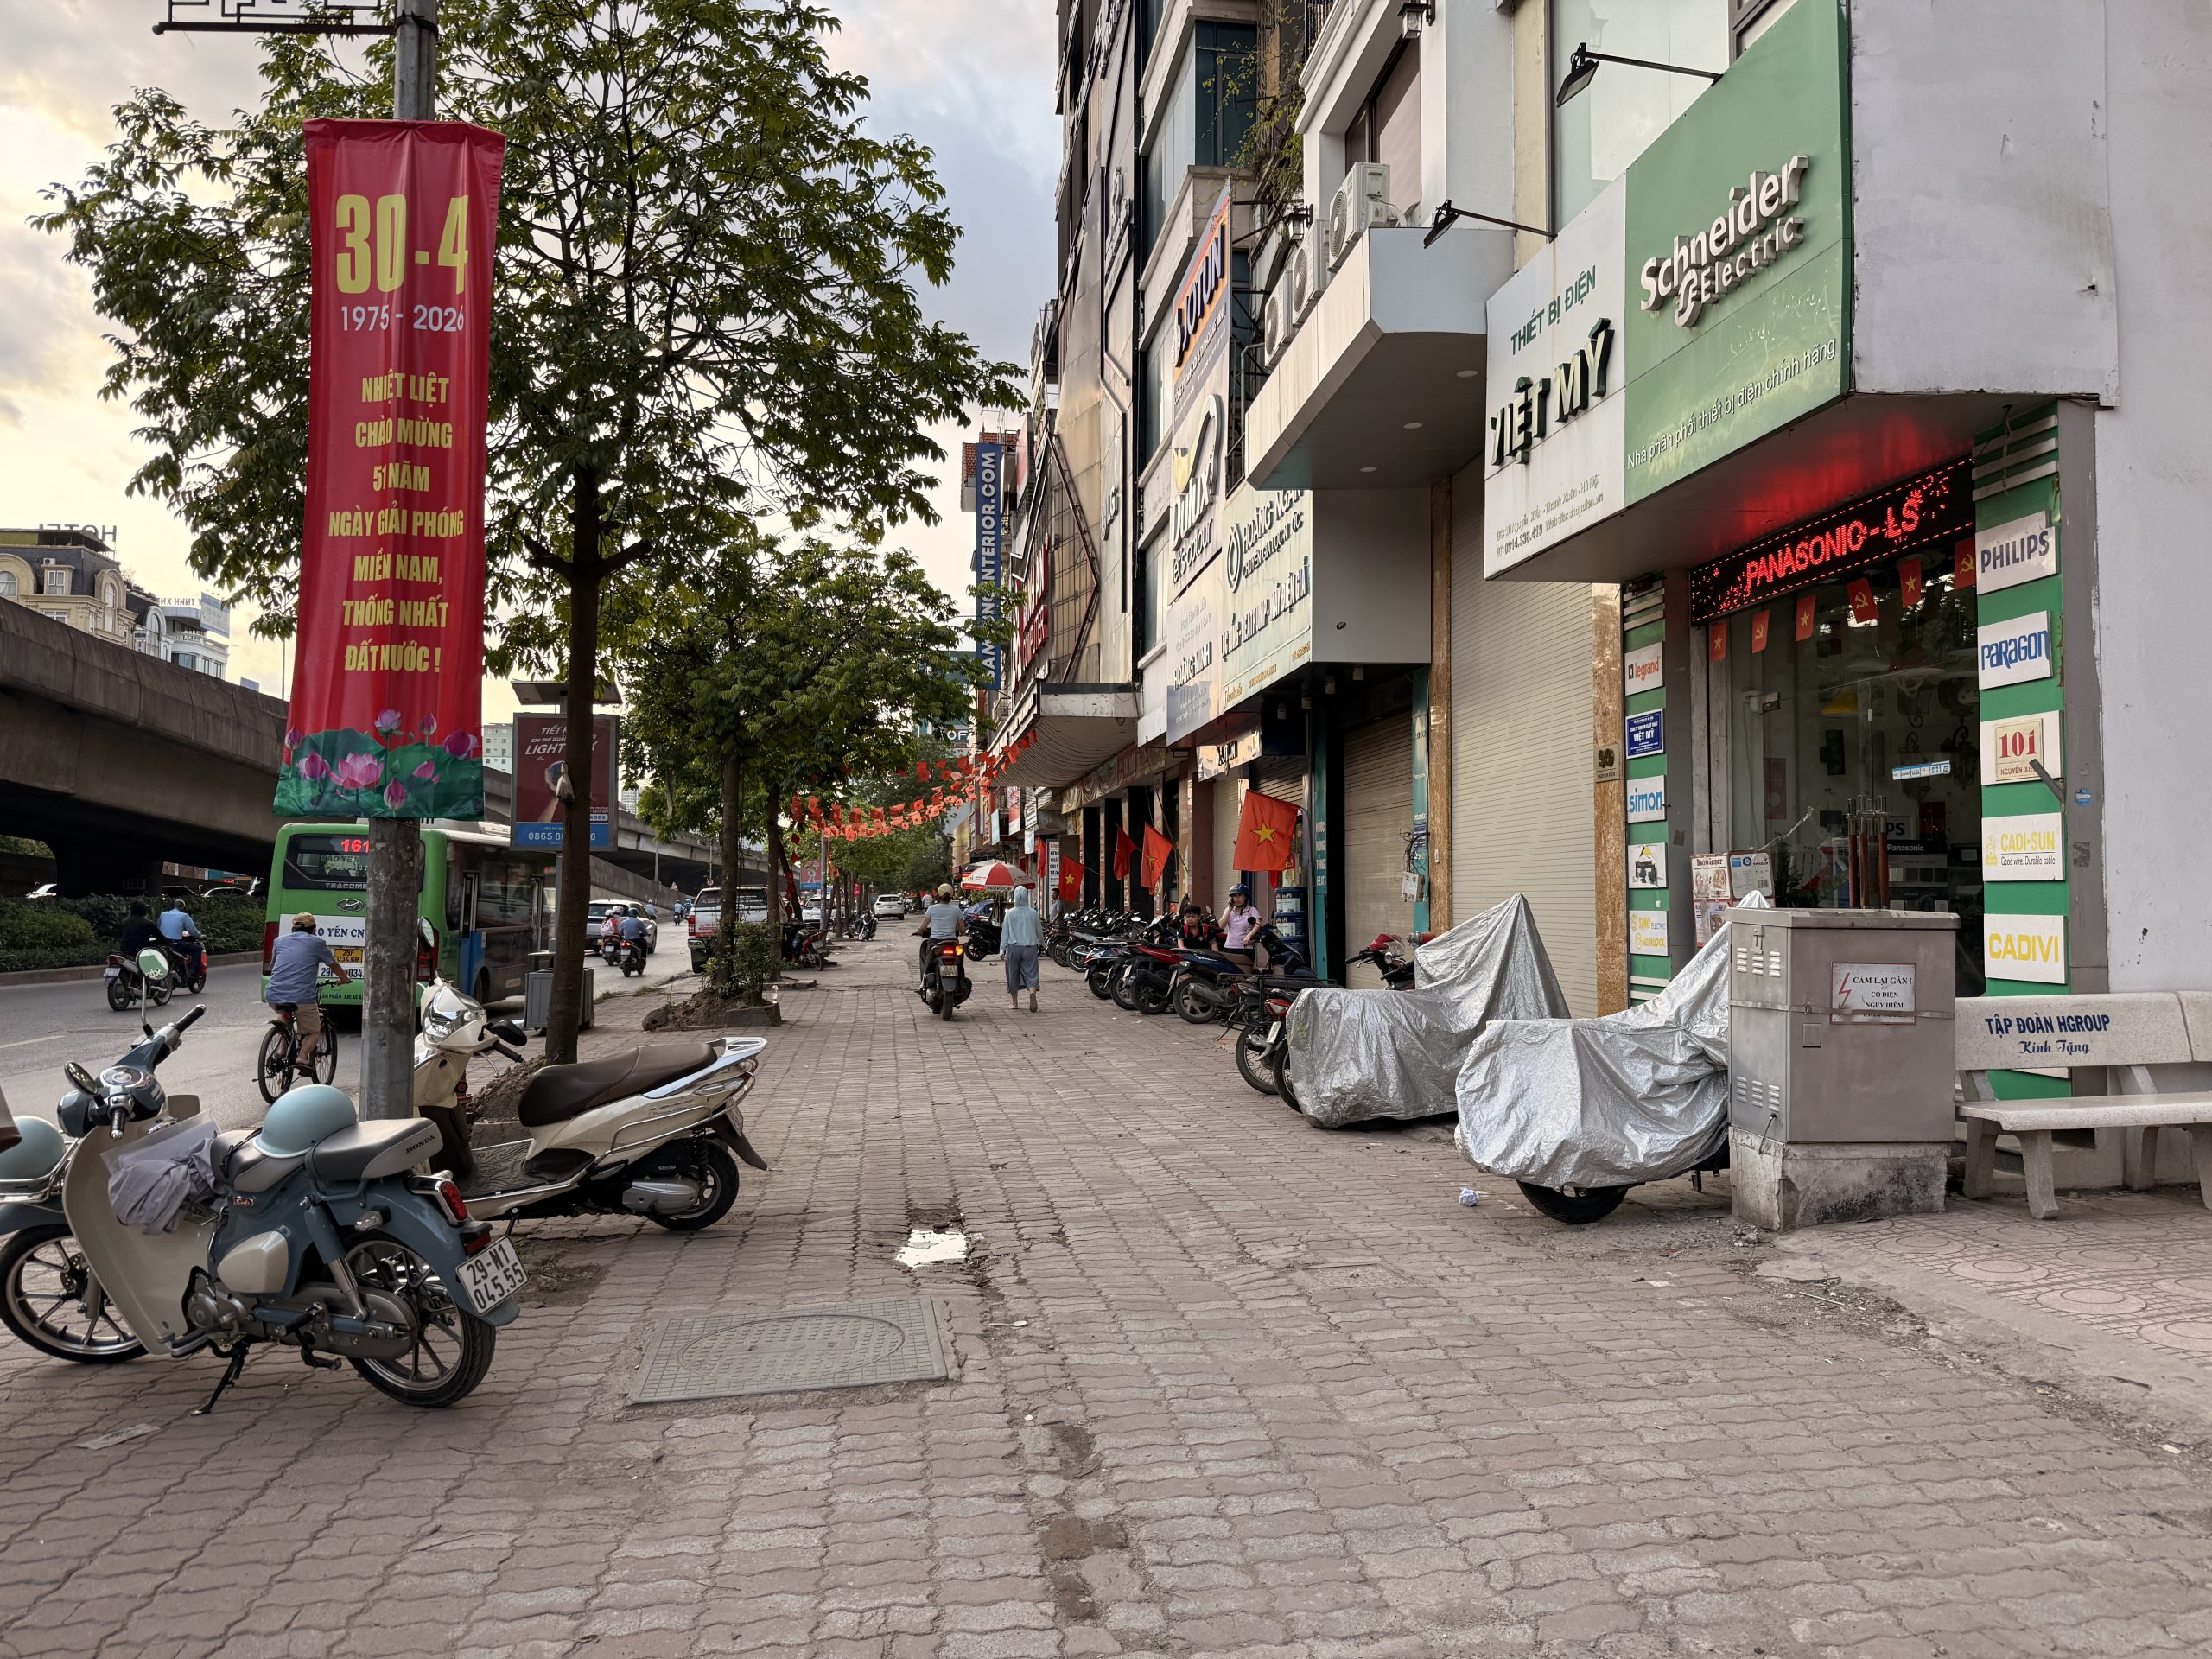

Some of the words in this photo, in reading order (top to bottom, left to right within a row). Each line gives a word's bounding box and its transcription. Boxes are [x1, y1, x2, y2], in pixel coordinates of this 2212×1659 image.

[1641, 154, 1809, 312] Schneider
[1700, 216, 1806, 304] Electric
[1182, 223, 1225, 353] JOTUN
[341, 305, 390, 332] 1975
[413, 304, 464, 333] 2026
[1510, 308, 1544, 356] THIẾT
[1548, 299, 1560, 327] BỊ
[1564, 265, 1597, 313] ĐIỆN
[362, 368, 406, 405] NHIỆT
[410, 372, 449, 408] LIỆT
[1628, 444, 1647, 470] Nhà
[1649, 434, 1673, 463] phân
[1675, 415, 1697, 451] phối
[1698, 398, 1723, 430] thiết
[1725, 392, 1736, 421] bị
[1738, 380, 1764, 412] điện
[1765, 359, 1801, 395] chính
[1803, 336, 1837, 376] hãng
[355, 415, 393, 448] CHÀO
[397, 415, 453, 448] MỪNG
[1491, 376, 1551, 467] VIỆT
[388, 460, 430, 492] NĂM
[328, 505, 374, 537] NGÀY
[378, 500, 408, 536] GIẢI
[411, 506, 464, 537] PHÓNG
[1172, 462, 1214, 551] Dulux
[1187, 518, 1213, 566] colour
[1244, 501, 1274, 554] HOÀNG
[354, 548, 391, 582] MIỀN
[396, 554, 443, 585] NAM,
[1980, 530, 2050, 573] PHILIPS
[343, 592, 394, 626] THỐNG
[399, 594, 449, 628] NHẤT
[345, 638, 379, 671] ĐẤT
[380, 639, 429, 671] NƯỚC
[1635, 659, 1660, 681] legrand
[541, 724, 563, 735] TIẾT
[1999, 729, 2037, 759] 101
[2000, 764, 2023, 775] NGUYỄN
[1629, 788, 1662, 812] simon
[528, 832, 553, 841] 0865
[1887, 843, 1925, 852] Panasonic
[2000, 855, 2013, 866] Good
[2024, 855, 2043, 866] Durable
[2043, 855, 2056, 865] cable
[327, 924, 348, 938] YẾN
[1988, 932, 2059, 963] CADIVI
[1874, 977, 1888, 986] LẠI
[1985, 1014, 2012, 1038] TẬP
[2017, 1012, 2055, 1034] ĐOÀN
[2056, 1014, 2111, 1033] HGROUP
[405, 1135, 435, 1154] HONDA
[467, 1244, 505, 1287] 29-N1
[473, 1262, 524, 1311] 045.55
